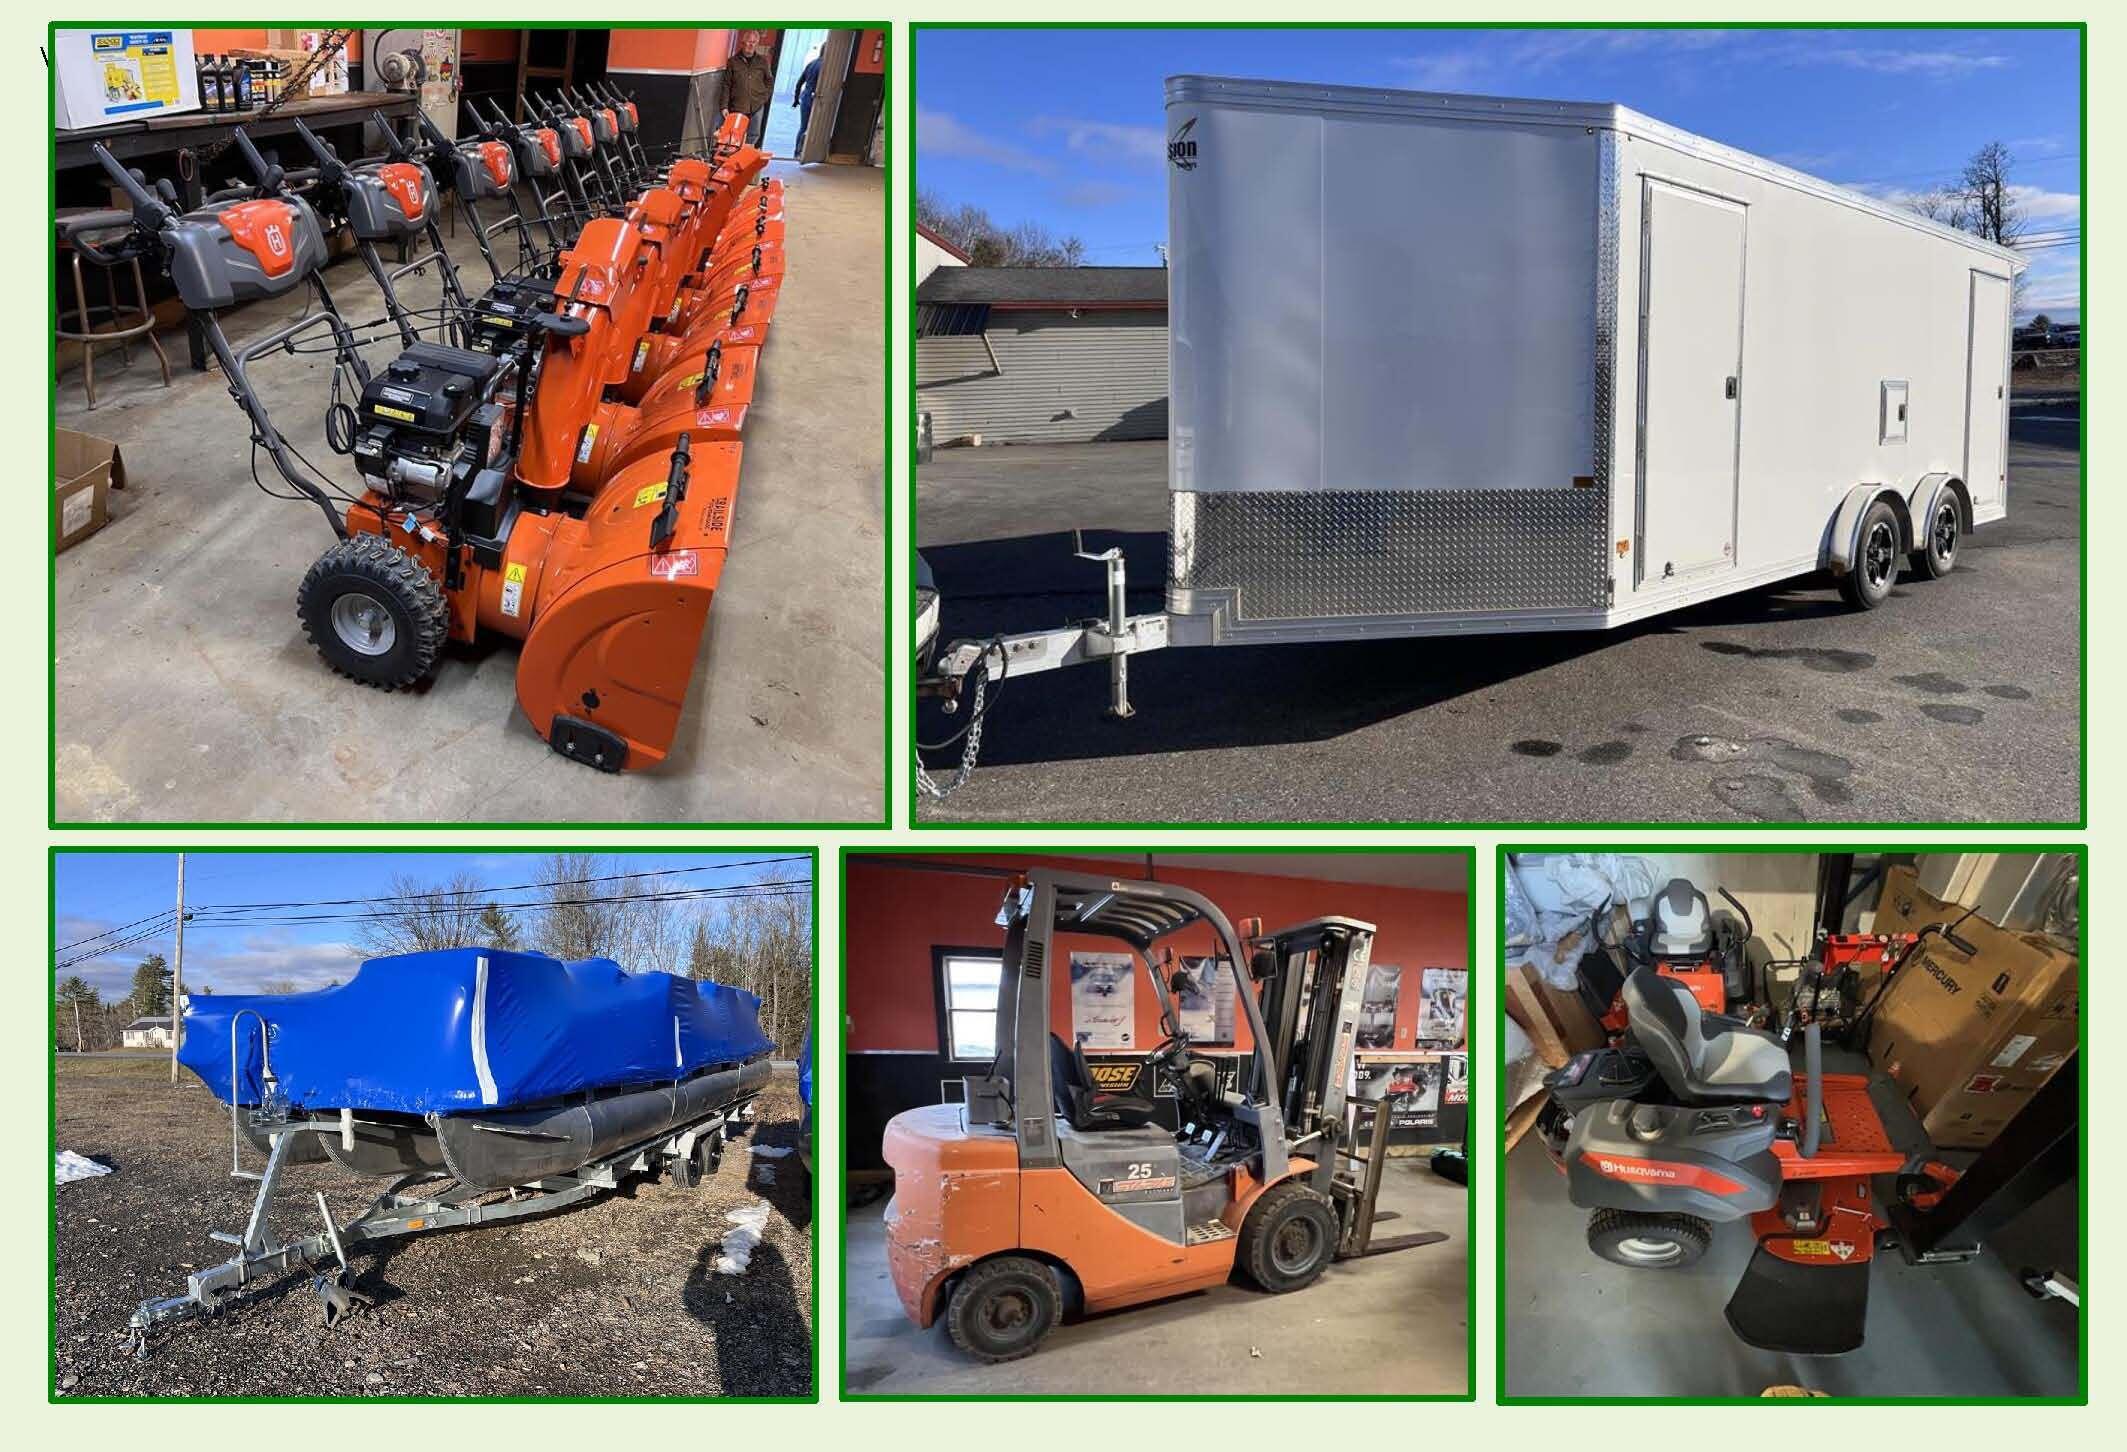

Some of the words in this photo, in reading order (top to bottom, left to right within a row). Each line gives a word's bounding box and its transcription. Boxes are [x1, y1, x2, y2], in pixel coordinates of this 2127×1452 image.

[1921, 956, 1962, 994] MERCURY
[1127, 1163, 1153, 1180] 25
[1613, 1162, 1677, 1179] Husqvarna
